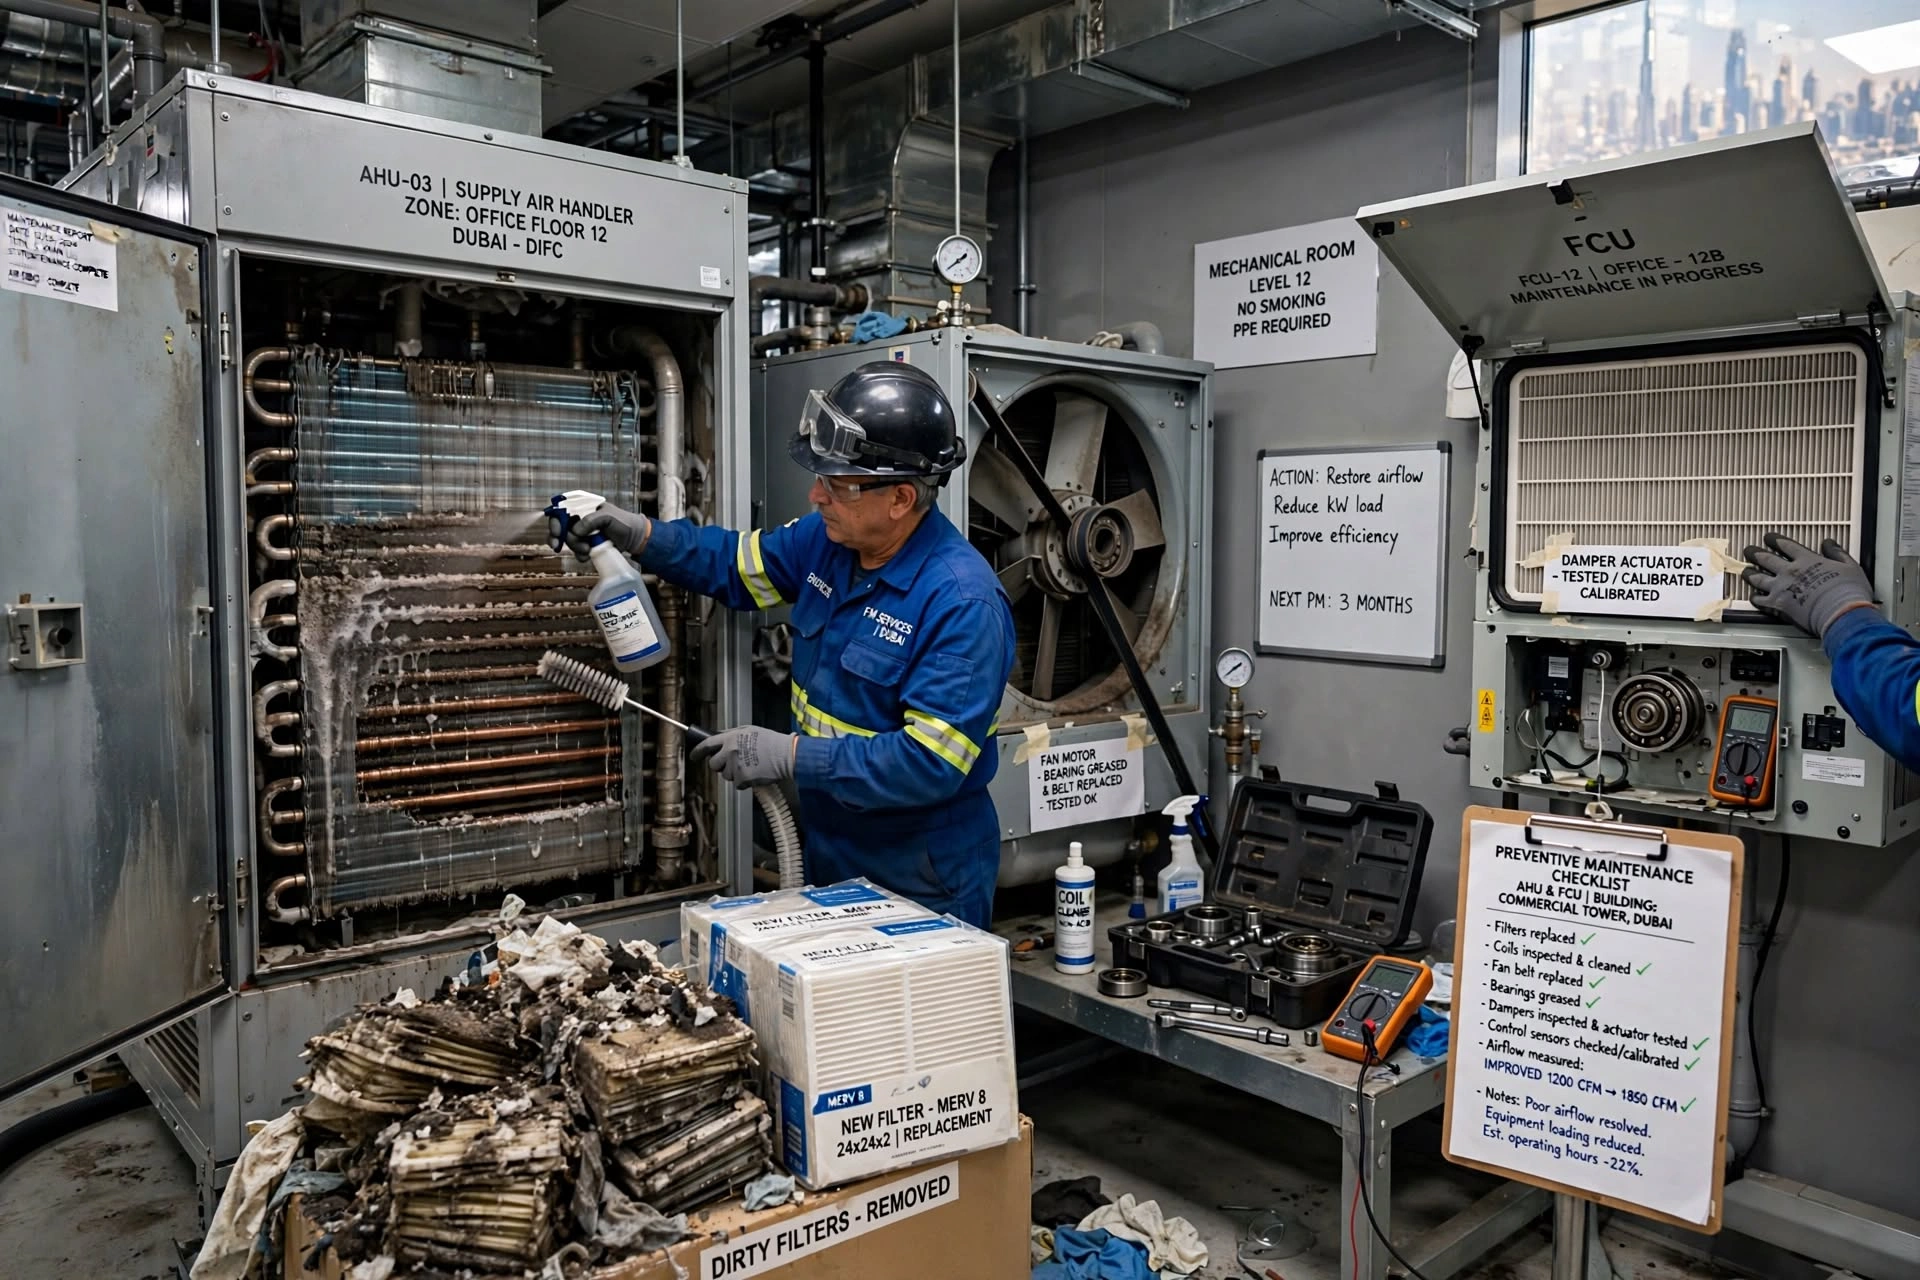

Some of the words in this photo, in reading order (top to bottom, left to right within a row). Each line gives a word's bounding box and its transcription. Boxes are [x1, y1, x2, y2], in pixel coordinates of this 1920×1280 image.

[360, 166, 432, 192] AHU-03
[456, 181, 521, 206] SUPPLY
[527, 194, 554, 212] AIR
[560, 198, 633, 225] HANDLER
[405, 196, 459, 220] ZONE:
[466, 207, 526, 230] OFFICE
[532, 217, 584, 239] FLOOR
[591, 226, 607, 242] 12
[453, 227, 507, 250] DUBAI
[526, 239, 563, 258] DIFC
[1563, 229, 1636, 256] FCU
[1209, 250, 1302, 279] MECHANICAL
[1306, 240, 1355, 263] ROOM
[1519, 268, 1583, 287] FCU-12
[1603, 257, 1668, 276] OFFICE
[1688, 249, 1725, 265] 12B
[1250, 275, 1291, 293] LEVEL
[1296, 271, 1310, 286] 12
[1510, 278, 1635, 305] MAINTENANCE
[1638, 275, 1658, 288] IN
[1662, 262, 1764, 285] PROGRESS
[1237, 301, 1256, 316] NO
[1260, 292, 1325, 314] SMOKING
[1233, 322, 1258, 337] PPE
[1262, 313, 1331, 334] REQUIRED
[1270, 468, 1319, 487] ACTION:
[1327, 466, 1372, 485] Restore
[1378, 465, 1423, 483] airflow
[1274, 495, 1319, 515] Reduce
[1356, 494, 1384, 513] load
[1269, 525, 1323, 549] Improve
[1330, 524, 1398, 555] efficiency
[1562, 555, 1616, 567] DAMPER
[1620, 556, 1692, 569] ACTUATOR
[1562, 571, 1609, 583] TESTED
[1622, 573, 1703, 586] CALIBRATED
[1270, 590, 1302, 607] NEXT
[1308, 592, 1331, 608] PM:
[1340, 593, 1349, 611] 3
[1357, 594, 1412, 614] MONTHS
[1580, 588, 1660, 601] CALIBRATED
[1041, 754, 1059, 766] FAN
[1062, 749, 1096, 763] MOTOR
[1044, 765, 1084, 781] BEARING
[1088, 759, 1127, 774] GREASED
[1043, 785, 1049, 796] &
[1052, 782, 1074, 795] BELT
[1077, 775, 1122, 791] REPLACED
[1046, 796, 1081, 811] TESTED
[1084, 793, 1097, 805] OK
[1496, 845, 1580, 868] PREVENTIVE
[1584, 857, 1693, 884] MAINTENANCE
[1552, 870, 1630, 891] CHECKLIST
[1059, 890, 1084, 905] COIL
[1516, 881, 1542, 894] AHU
[1546, 885, 1554, 897] &
[1558, 887, 1582, 900] FCU
[1594, 892, 1657, 912] BUILDING:
[752, 918, 782, 927] NEW
[1499, 893, 1579, 915] COMMERCIAL
[1583, 905, 1630, 925] TOWER,
[1634, 916, 1673, 930] DUBAI
[1495, 921, 1526, 937] Filters
[1530, 927, 1575, 944] replaced
[802, 949, 833, 957] NEW
[1493, 940, 1518, 956] Coils
[1522, 945, 1572, 965] inspected
[1577, 955, 1584, 967] &
[1588, 956, 1631, 975] cleaned
[1492, 960, 1511, 973] Fan
[1515, 963, 1534, 978] belt
[1538, 970, 1583, 987] replaced
[1491, 979, 1535, 999] Bearings
[1539, 991, 1581, 1007] greased
[1489, 999, 1534, 1019] Dampers
[1538, 1009, 1587, 1029] inspected
[1591, 1019, 1599, 1031] &
[1603, 1023, 1650, 1042] actuator
[1653, 1033, 1688, 1050] tested
[1487, 1039, 1524, 1057] Airflow
[1529, 1050, 1584, 1070] measured:
[1488, 1019, 1526, 1036] Control
[1531, 1029, 1570, 1046] sensors
[1574, 1037, 1679, 1070] checked/calibrated
[1484, 1058, 1542, 1080] IMPROVED
[1548, 1072, 1573, 1088] 1200
[1577, 1079, 1602, 1095] CFM
[1622, 1089, 1647, 1105] 1850
[1652, 1097, 1677, 1112] CFM
[828, 1092, 854, 1109] MERV
[858, 1090, 864, 1101] 8
[841, 1114, 874, 1135] NEW
[878, 1103, 924, 1127] FILTER
[937, 1090, 975, 1114] MERV
[979, 1089, 986, 1104] 8
[1485, 1087, 1520, 1106] Notes:
[1525, 1096, 1550, 1113] Poor
[1554, 1105, 1595, 1124] airflow
[1600, 1117, 1651, 1138] resolved.
[837, 1132, 890, 1157] 24x24x2
[904, 1108, 992, 1142] REPLACEMENT
[1485, 1106, 1544, 1131] Equipment
[1549, 1121, 1589, 1147] loading
[1594, 1136, 1645, 1156] reduced.
[1483, 1125, 1504, 1140] Est.
[1509, 1134, 1561, 1158] operating
[1566, 1144, 1598, 1165] hours
[1603, 1159, 1643, 1176] -22%.
[711, 1239, 771, 1280] DIRTY
[777, 1211, 849, 1256] FILTERS
[867, 1175, 950, 1222] REMOVED
